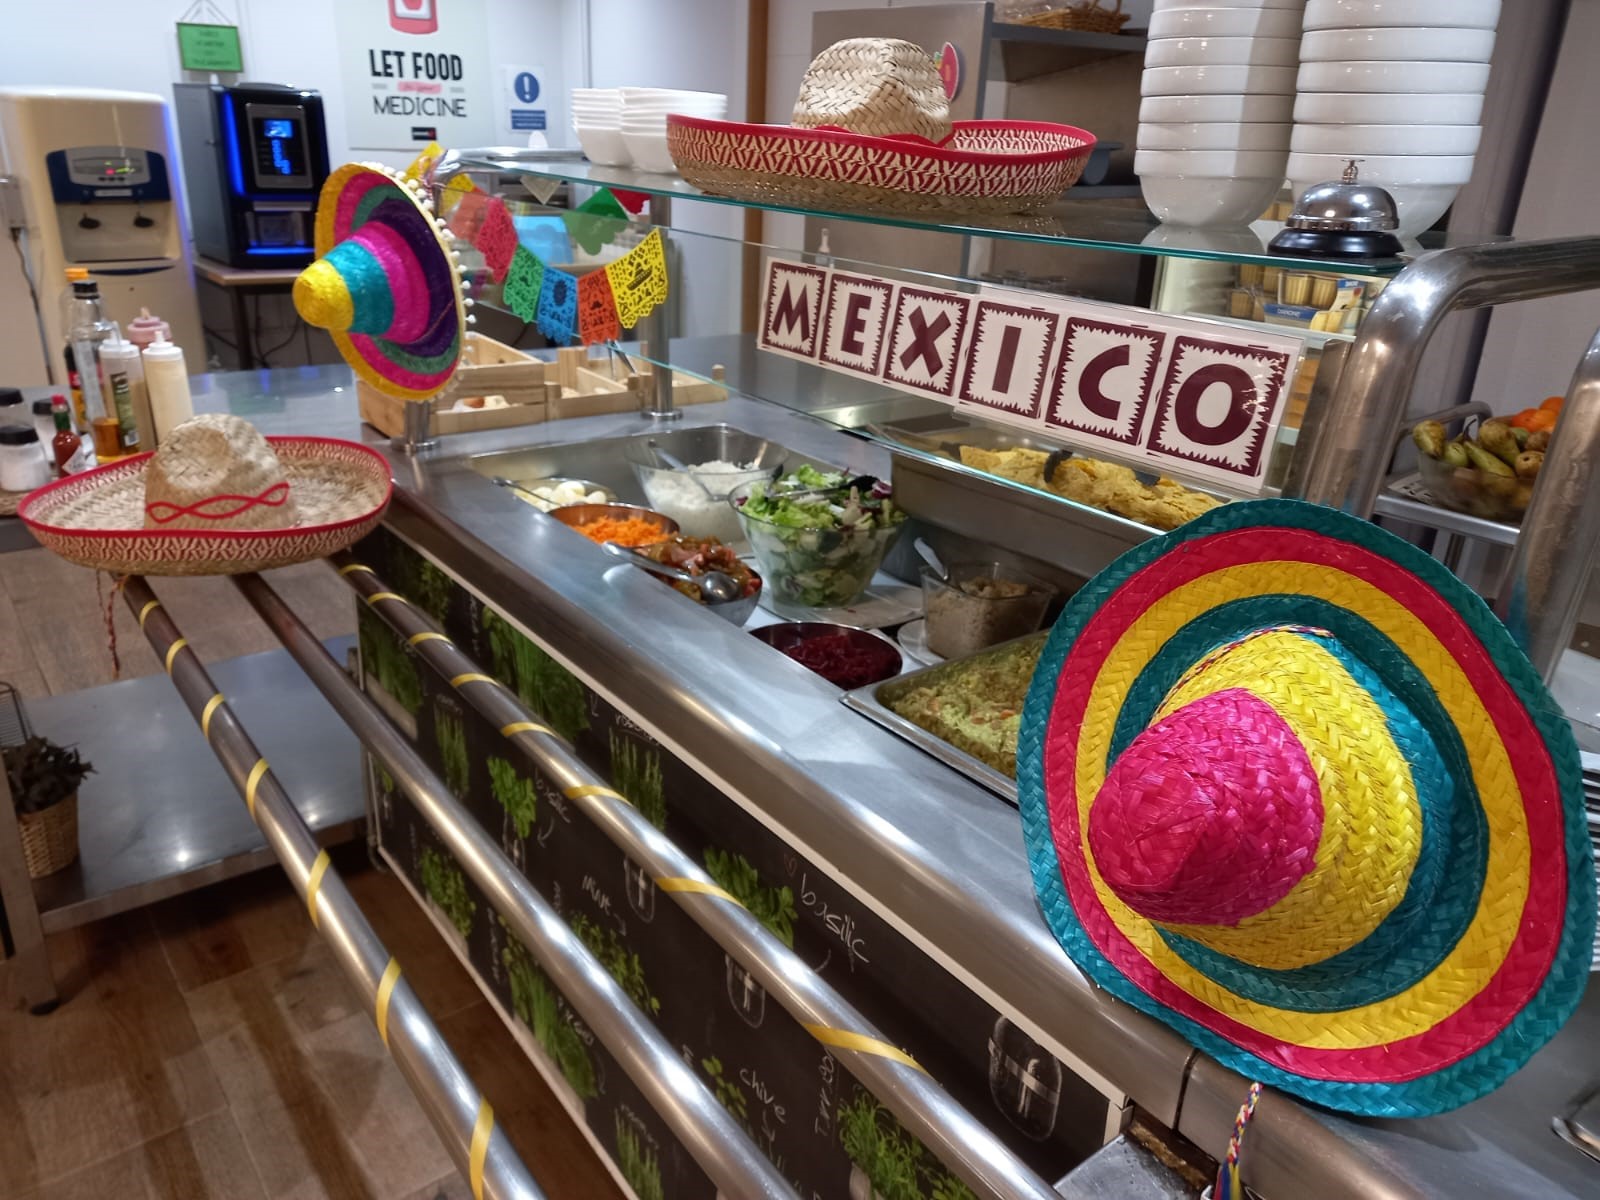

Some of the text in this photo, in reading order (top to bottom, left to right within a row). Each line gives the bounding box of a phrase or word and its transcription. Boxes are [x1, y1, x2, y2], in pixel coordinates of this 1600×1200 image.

[369, 49, 463, 81] LET FOOD
[373, 96, 467, 117] MEDICINE
[771, 280, 1259, 446] MEXICO
[801, 873, 869, 963] basilic
